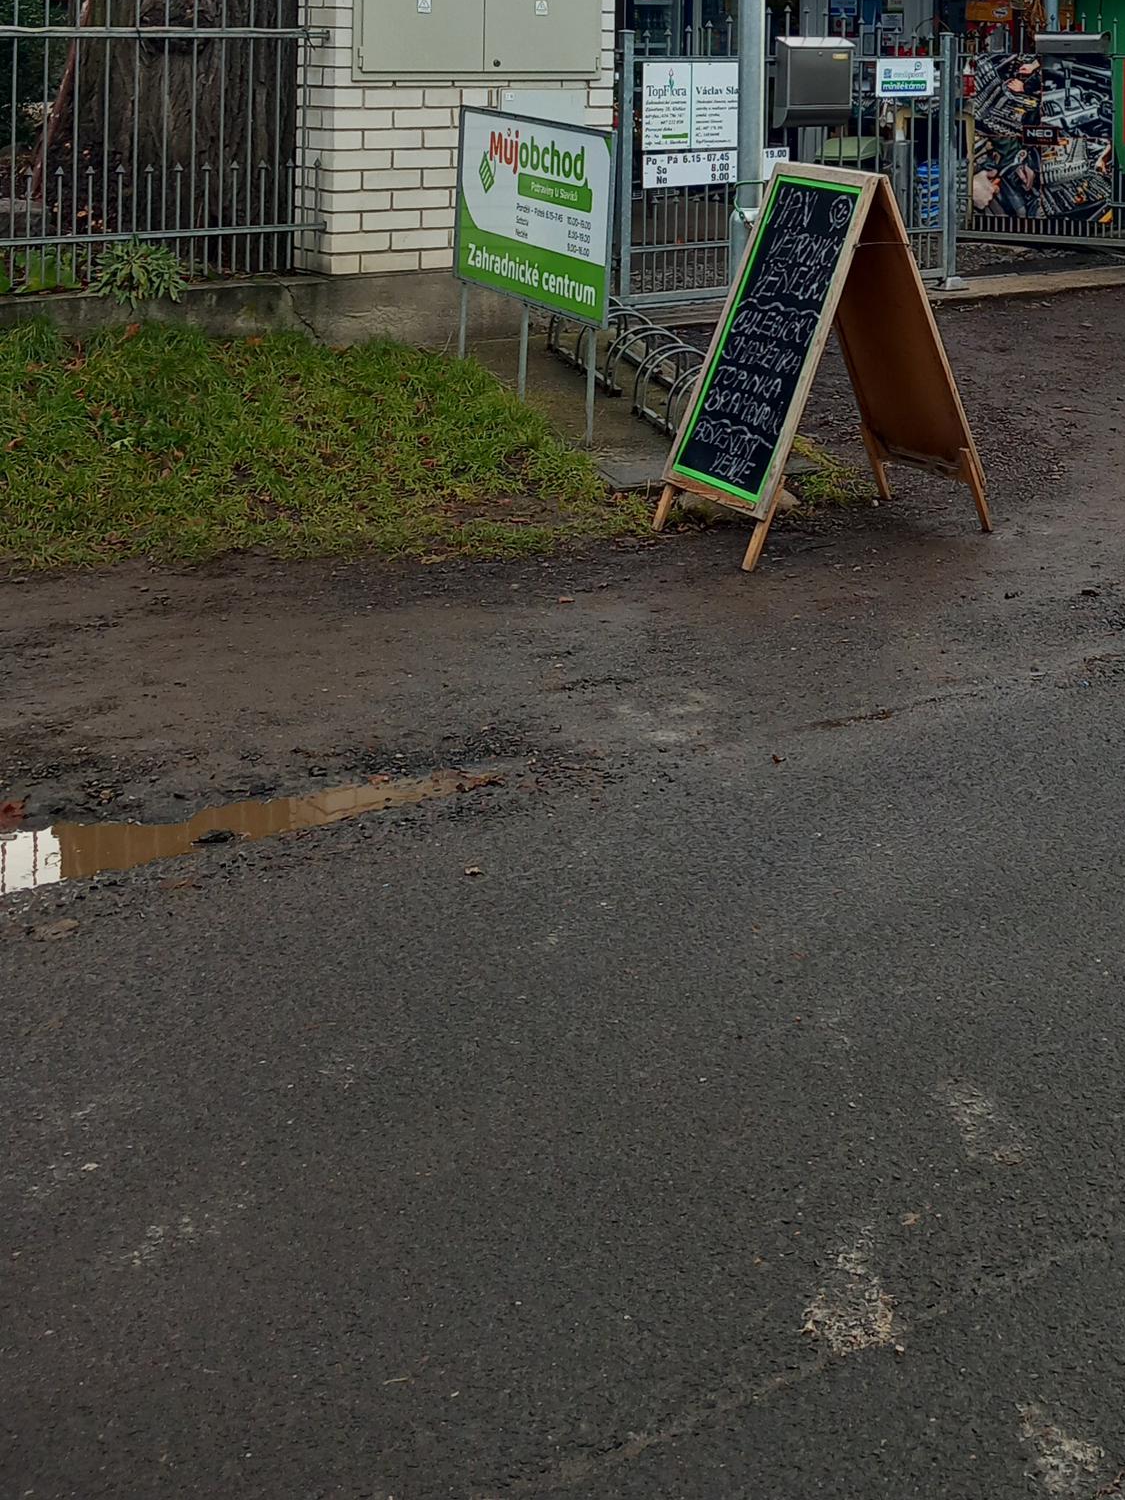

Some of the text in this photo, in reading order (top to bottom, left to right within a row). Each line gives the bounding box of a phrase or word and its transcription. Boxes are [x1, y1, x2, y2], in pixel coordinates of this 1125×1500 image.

[695, 86, 724, 96] Václav
[725, 86, 739, 96] Sla
[1026, 129, 1053, 138] NEO
[489, 128, 585, 181] Můjobchod
[646, 156, 657, 166] Po
[667, 155, 678, 165] Pá
[765, 149, 787, 159] 19.00
[656, 166, 667, 175] So
[711, 163, 730, 172] 8.00
[656, 175, 667, 185] Ne
[711, 172, 730, 182] 9.00
[467, 243, 597, 307] Zahradnické centrum
[713, 365, 782, 399] TOPINKA
